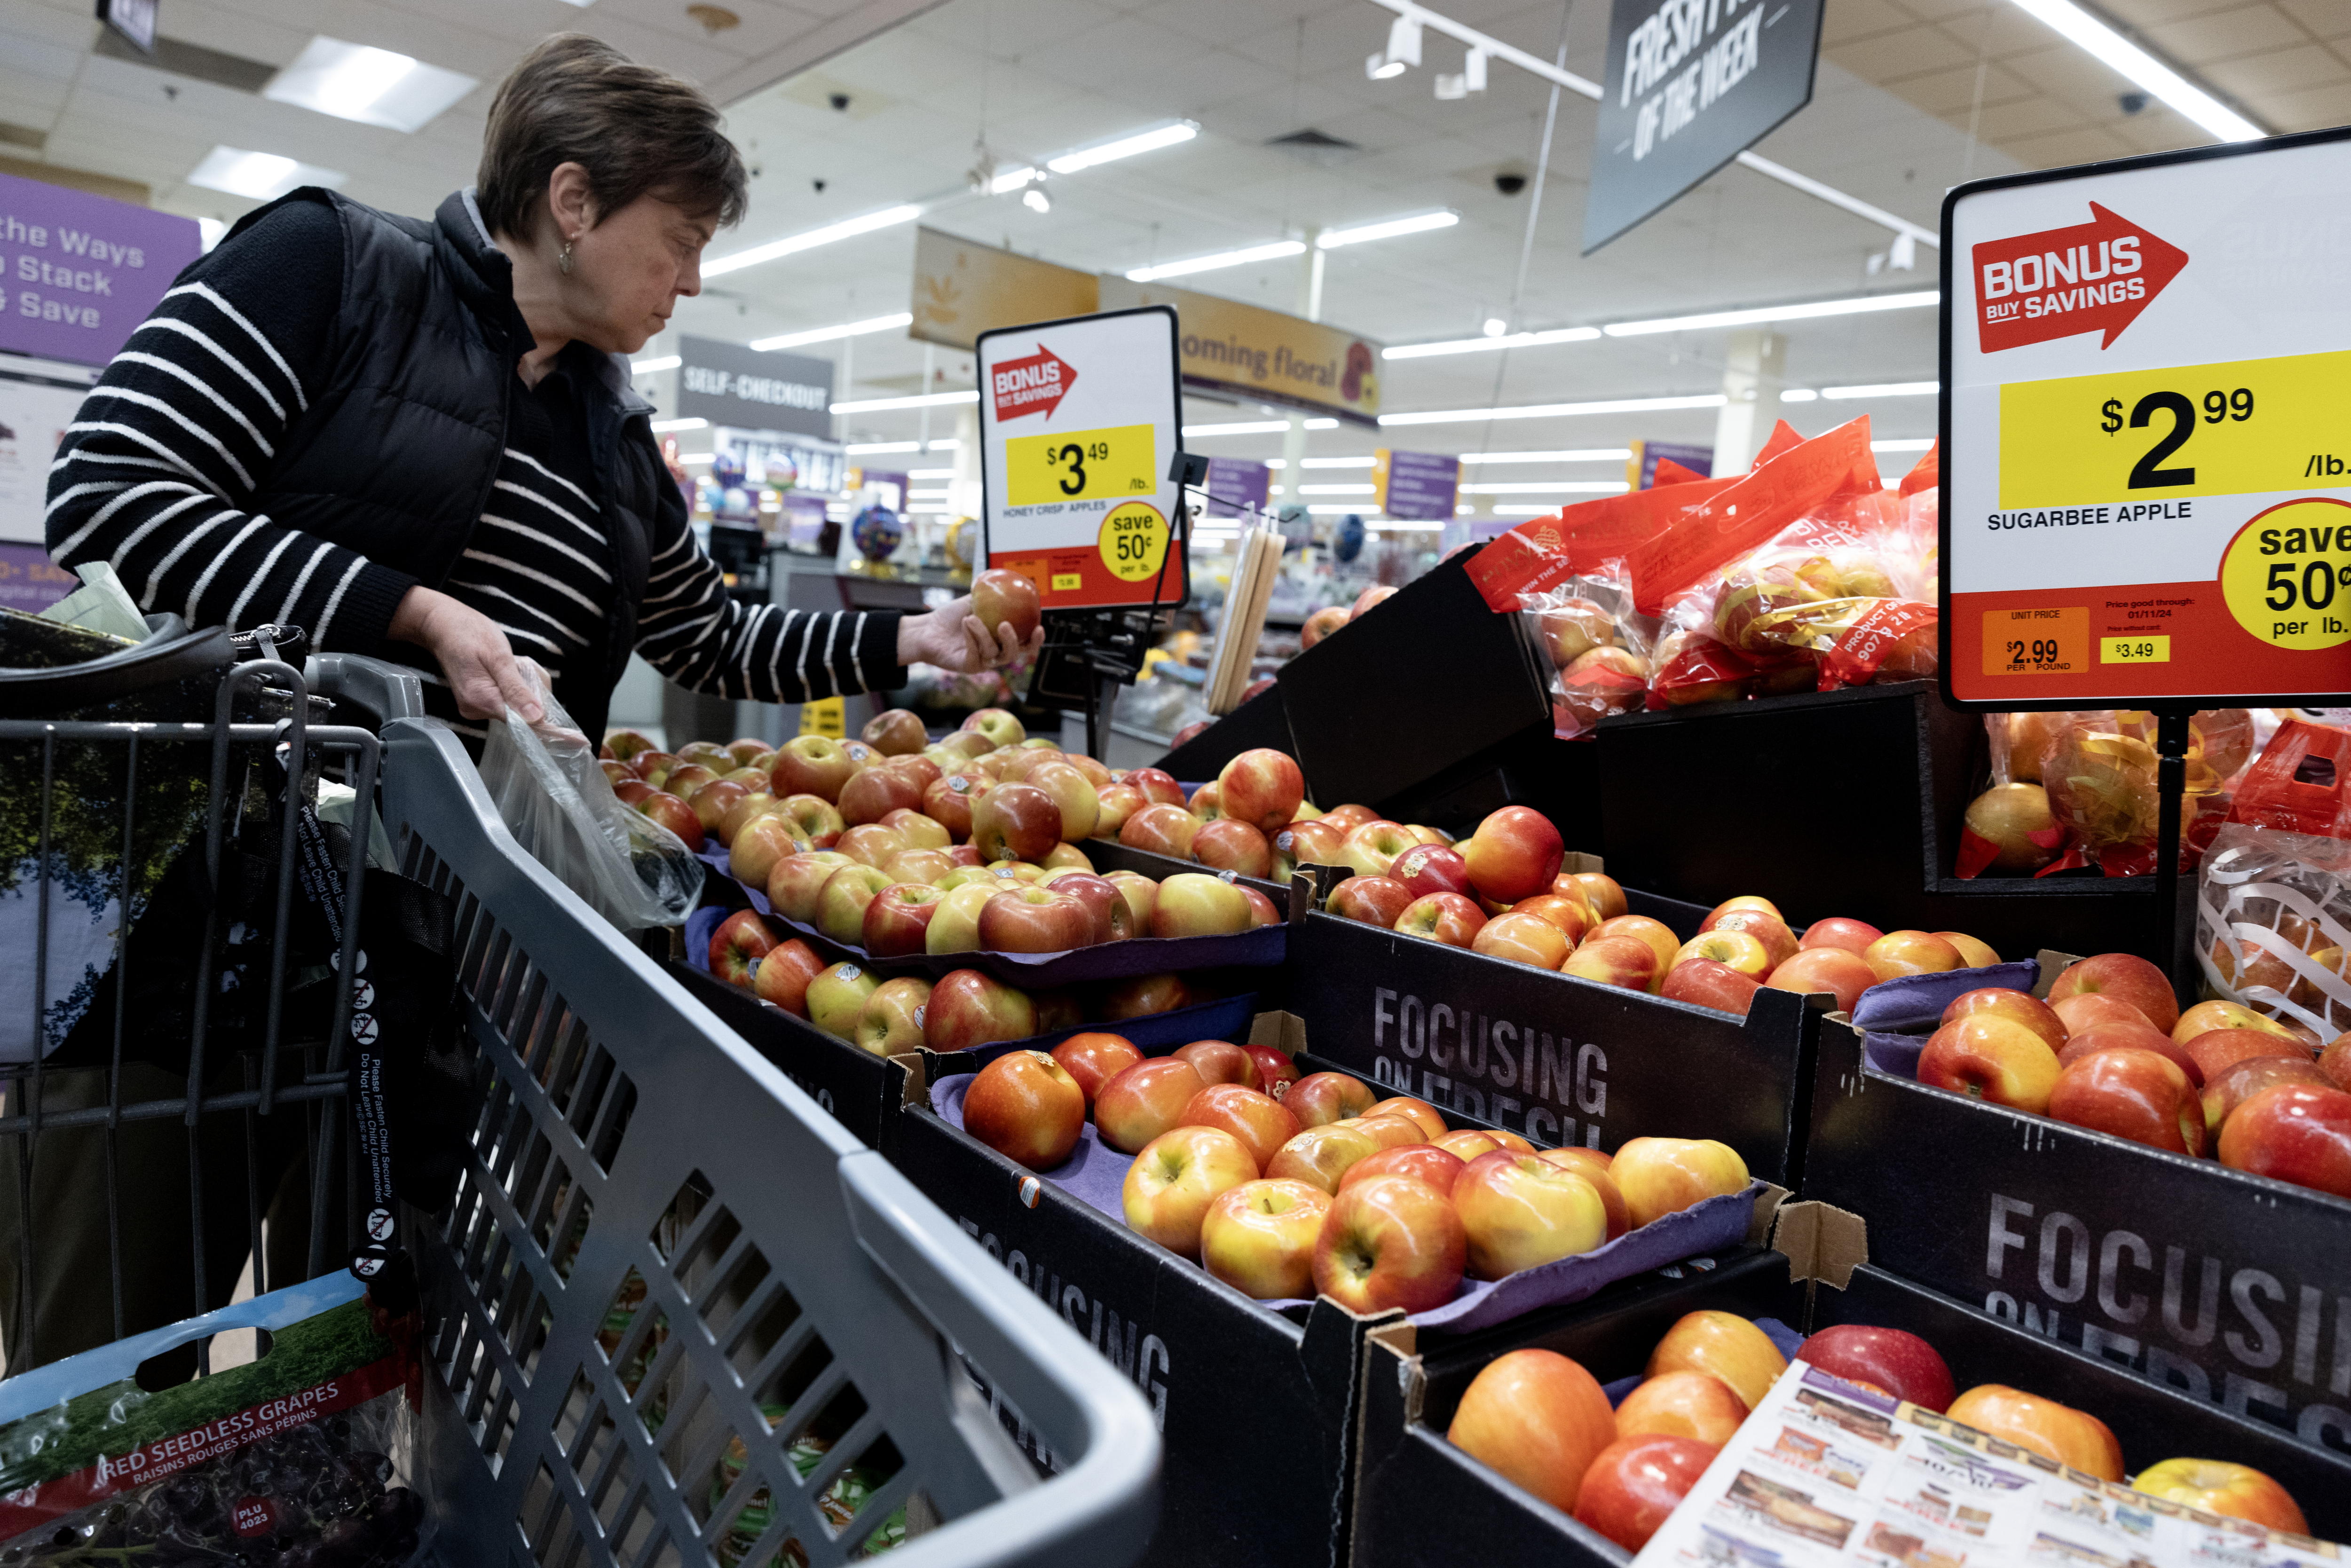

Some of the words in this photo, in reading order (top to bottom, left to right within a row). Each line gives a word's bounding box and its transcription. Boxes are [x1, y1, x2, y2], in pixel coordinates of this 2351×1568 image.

[58, 226, 145, 269] Ways
[18, 254, 112, 297] Stack
[1983, 236, 2143, 300] BONUS
[19, 291, 101, 329] Save
[1986, 301, 2020, 320] BUY
[2025, 277, 2146, 319] SAVINGS
[995, 360, 1061, 394] BONUS
[1273, 346, 1337, 388] floral
[1013, 382, 1063, 405] SAVINGS
[1129, 478, 1149, 490] /lb.
[1003, 506, 1034, 517] HONEY
[1036, 504, 1064, 516] CRISP
[1069, 500, 1106, 512] APPLES
[1113, 514, 1153, 531] save
[1987, 507, 2109, 530] SUGARBEE
[2117, 501, 2193, 522] APPLE
[2260, 525, 2351, 555] save
[2011, 611, 2033, 620] UNIT
[2034, 610, 2060, 619] PRICE
[2106, 600, 2129, 609] Price
[2130, 599, 2154, 609] good
[2156, 598, 2195, 607] through:
[2128, 609, 2172, 619] 01/11/24
[1844, 608, 1888, 653] PRODUCT
[2273, 621, 2309, 639] per
[2322, 616, 2348, 633] lb.
[1858, 633, 1882, 662] 907
[2006, 638, 2058, 664] $2.99
[2115, 643, 2154, 658] $3.49
[2036, 662, 2071, 671] POUND
[300, 805, 322, 839] Please
[316, 837, 332, 870] Fasten
[327, 870, 342, 895] Child
[302, 841, 316, 868] Leave
[311, 868, 328, 893] Child
[361, 1053, 370, 1068] Do
[1374, 986, 1608, 1117] FOCUSING
[360, 1070, 370, 1088] Not
[371, 1059, 381, 1092] Please
[361, 1091, 373, 1118] Leave
[374, 1094, 386, 1126] Fasten
[368, 1120, 379, 1145] Child
[379, 1128, 389, 1153] Child
[371, 1147, 383, 1203] Unattended
[381, 1156, 393, 1198] Securely
[103, 1452, 146, 1480] RED
[154, 1411, 254, 1462] SEEDLESS
[259, 1382, 339, 1420] GRAPES
[133, 1459, 185, 1485] RAISINS
[188, 1437, 238, 1464] ROUGES
[240, 1425, 273, 1444] SANS
[276, 1408, 318, 1430] PÉPINS
[238, 1504, 263, 1520] PLU
[240, 1513, 268, 1530] 4023
